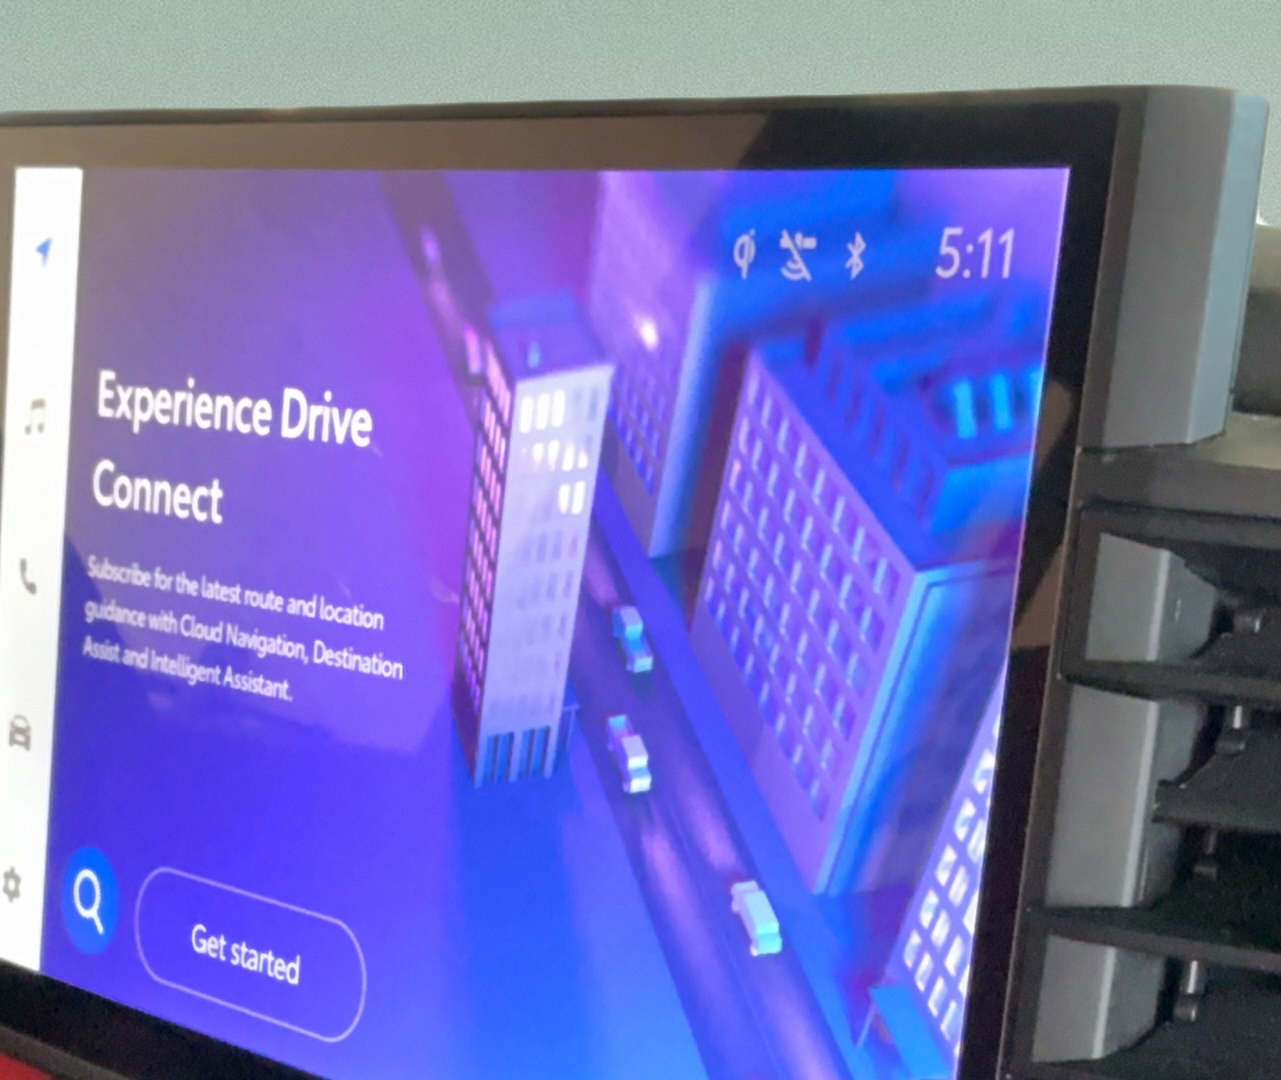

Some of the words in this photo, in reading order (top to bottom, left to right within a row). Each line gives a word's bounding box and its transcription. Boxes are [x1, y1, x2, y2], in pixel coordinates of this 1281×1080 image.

[935, 226, 1015, 279] 5:11
[97, 369, 271, 436] Experience
[280, 387, 373, 448] Drive
[92, 459, 224, 524] Connect
[87, 555, 151, 588] Subscribe
[153, 566, 173, 591] for
[176, 571, 199, 597] the
[201, 574, 241, 604] latest
[244, 589, 284, 613] route
[286, 593, 317, 618] and
[319, 595, 384, 631] location
[83, 635, 120, 663] Assist
[122, 646, 149, 669] and
[150, 650, 222, 686] Intelligent
[223, 664, 293, 702] Assistant.
[84, 599, 146, 628] guidance
[148, 609, 178, 634] with
[180, 614, 224, 643] Cloud
[226, 622, 309, 665] Navigation,
[313, 639, 404, 680] Destination
[191, 923, 227, 962] Get
[230, 939, 301, 985] started
